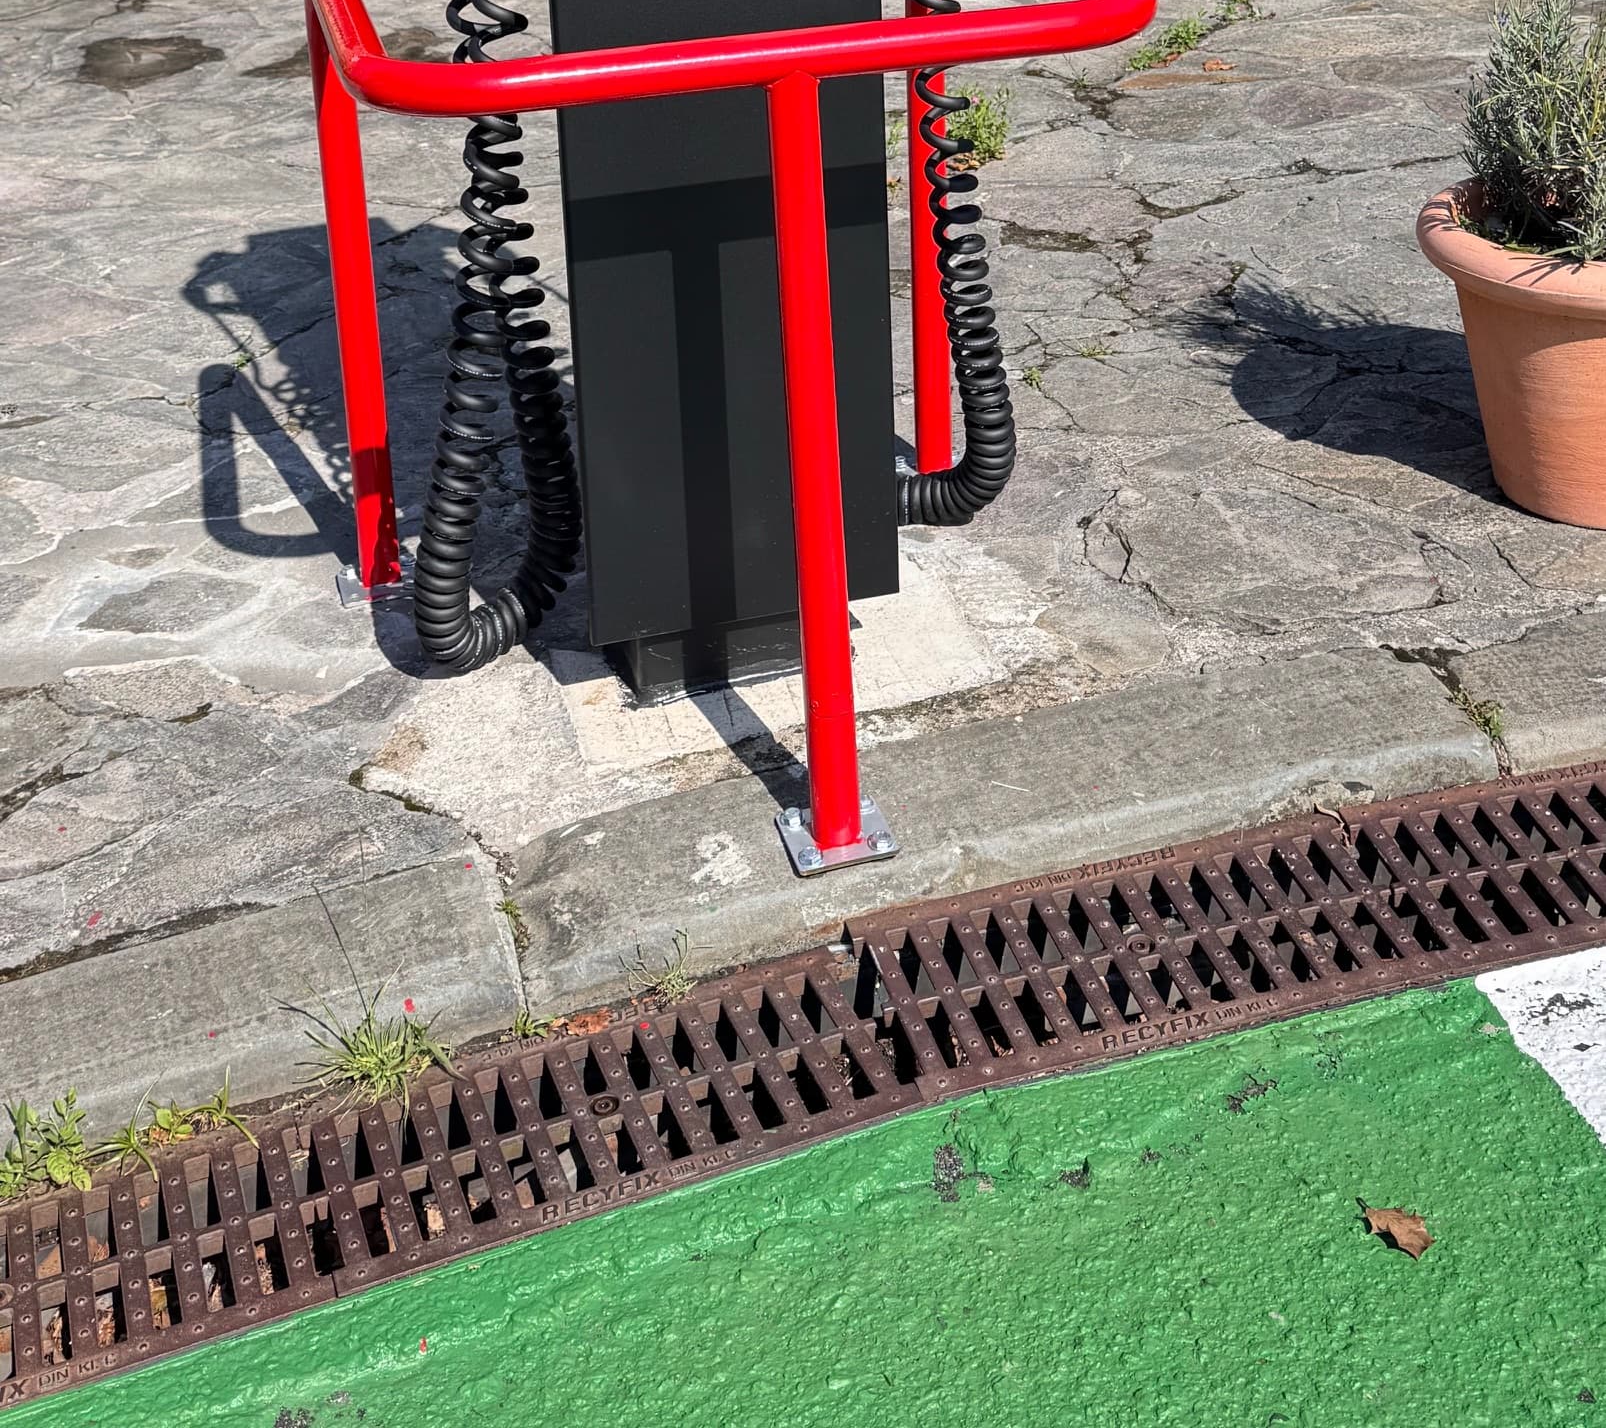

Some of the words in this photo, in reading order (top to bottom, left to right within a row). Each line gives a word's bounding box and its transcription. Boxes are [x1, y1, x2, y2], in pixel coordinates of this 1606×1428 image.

[1048, 871, 1072, 886] DIN
[1078, 845, 1177, 880] RECYFIX
[1101, 1011, 1213, 1051] RECYFIX
[1215, 1005, 1241, 1021] DIN
[541, 1171, 663, 1223] RECYFIX
[668, 1161, 697, 1177] DIN
[39, 1369, 70, 1388] DIN
